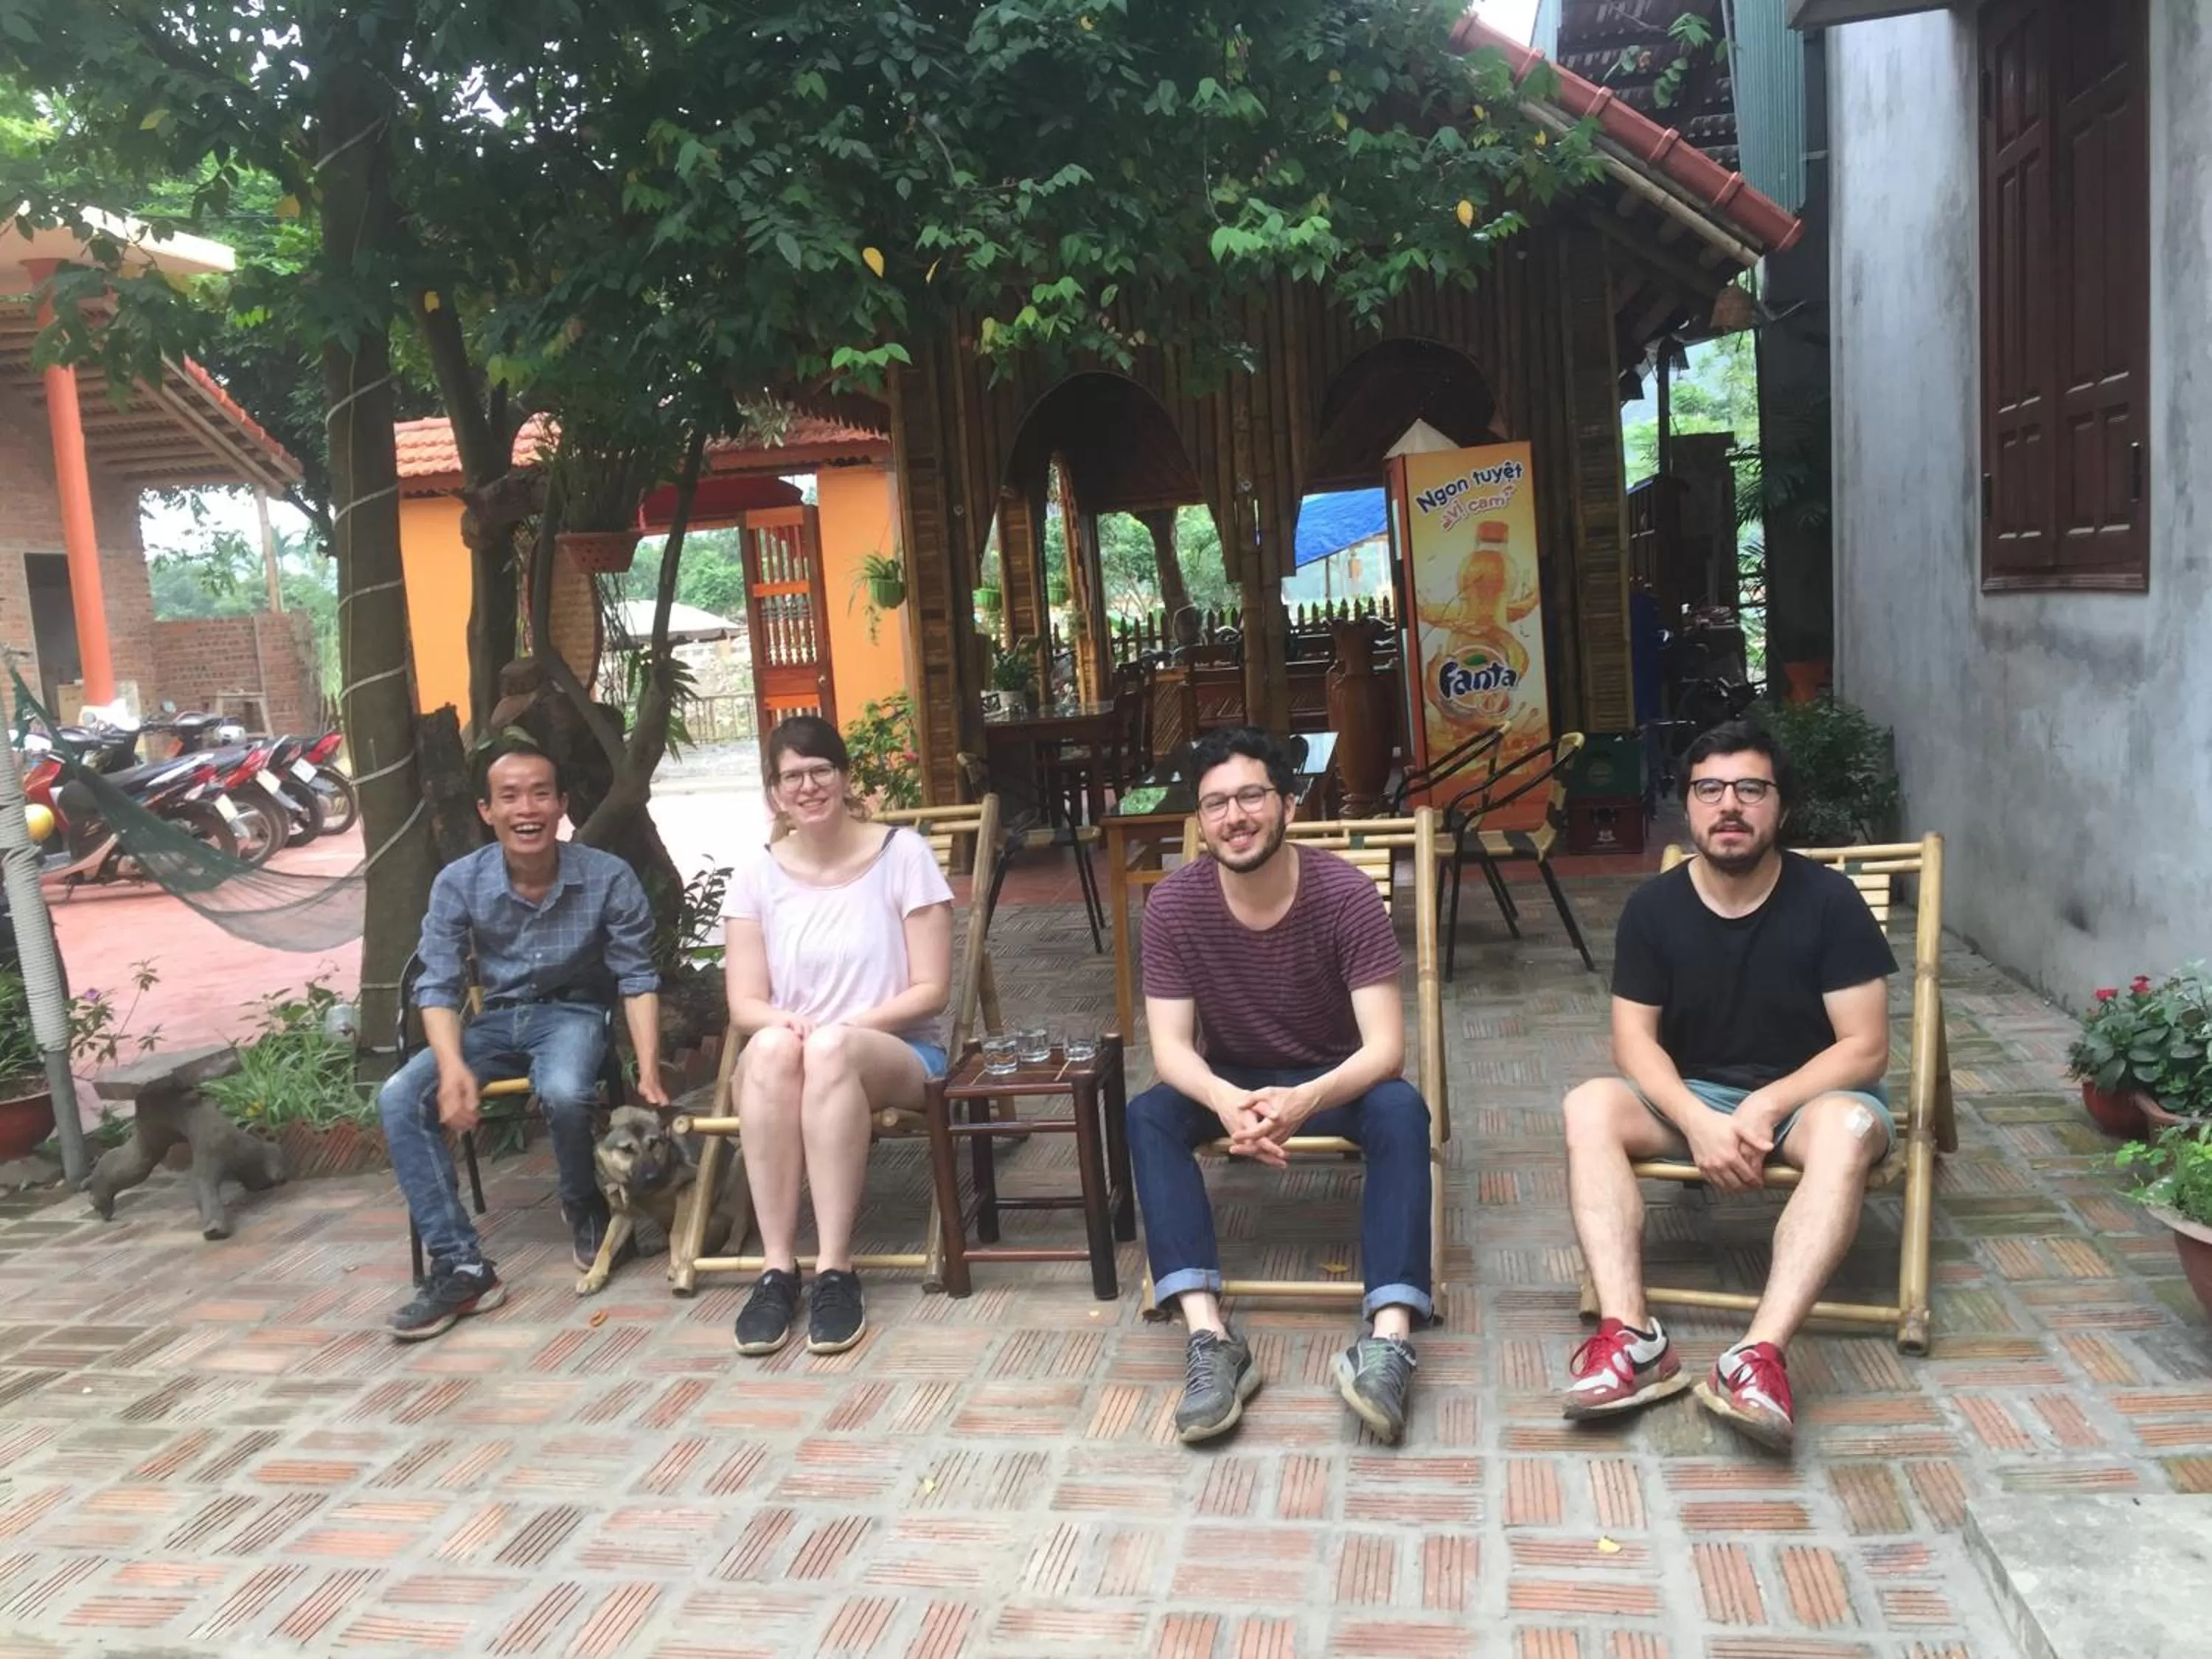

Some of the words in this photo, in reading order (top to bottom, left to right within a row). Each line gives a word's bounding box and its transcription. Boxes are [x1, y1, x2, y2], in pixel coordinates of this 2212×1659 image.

[1416, 479, 1469, 513] Ngon
[1472, 461, 1523, 485] tuyệt
[1468, 496, 1505, 512] cam
